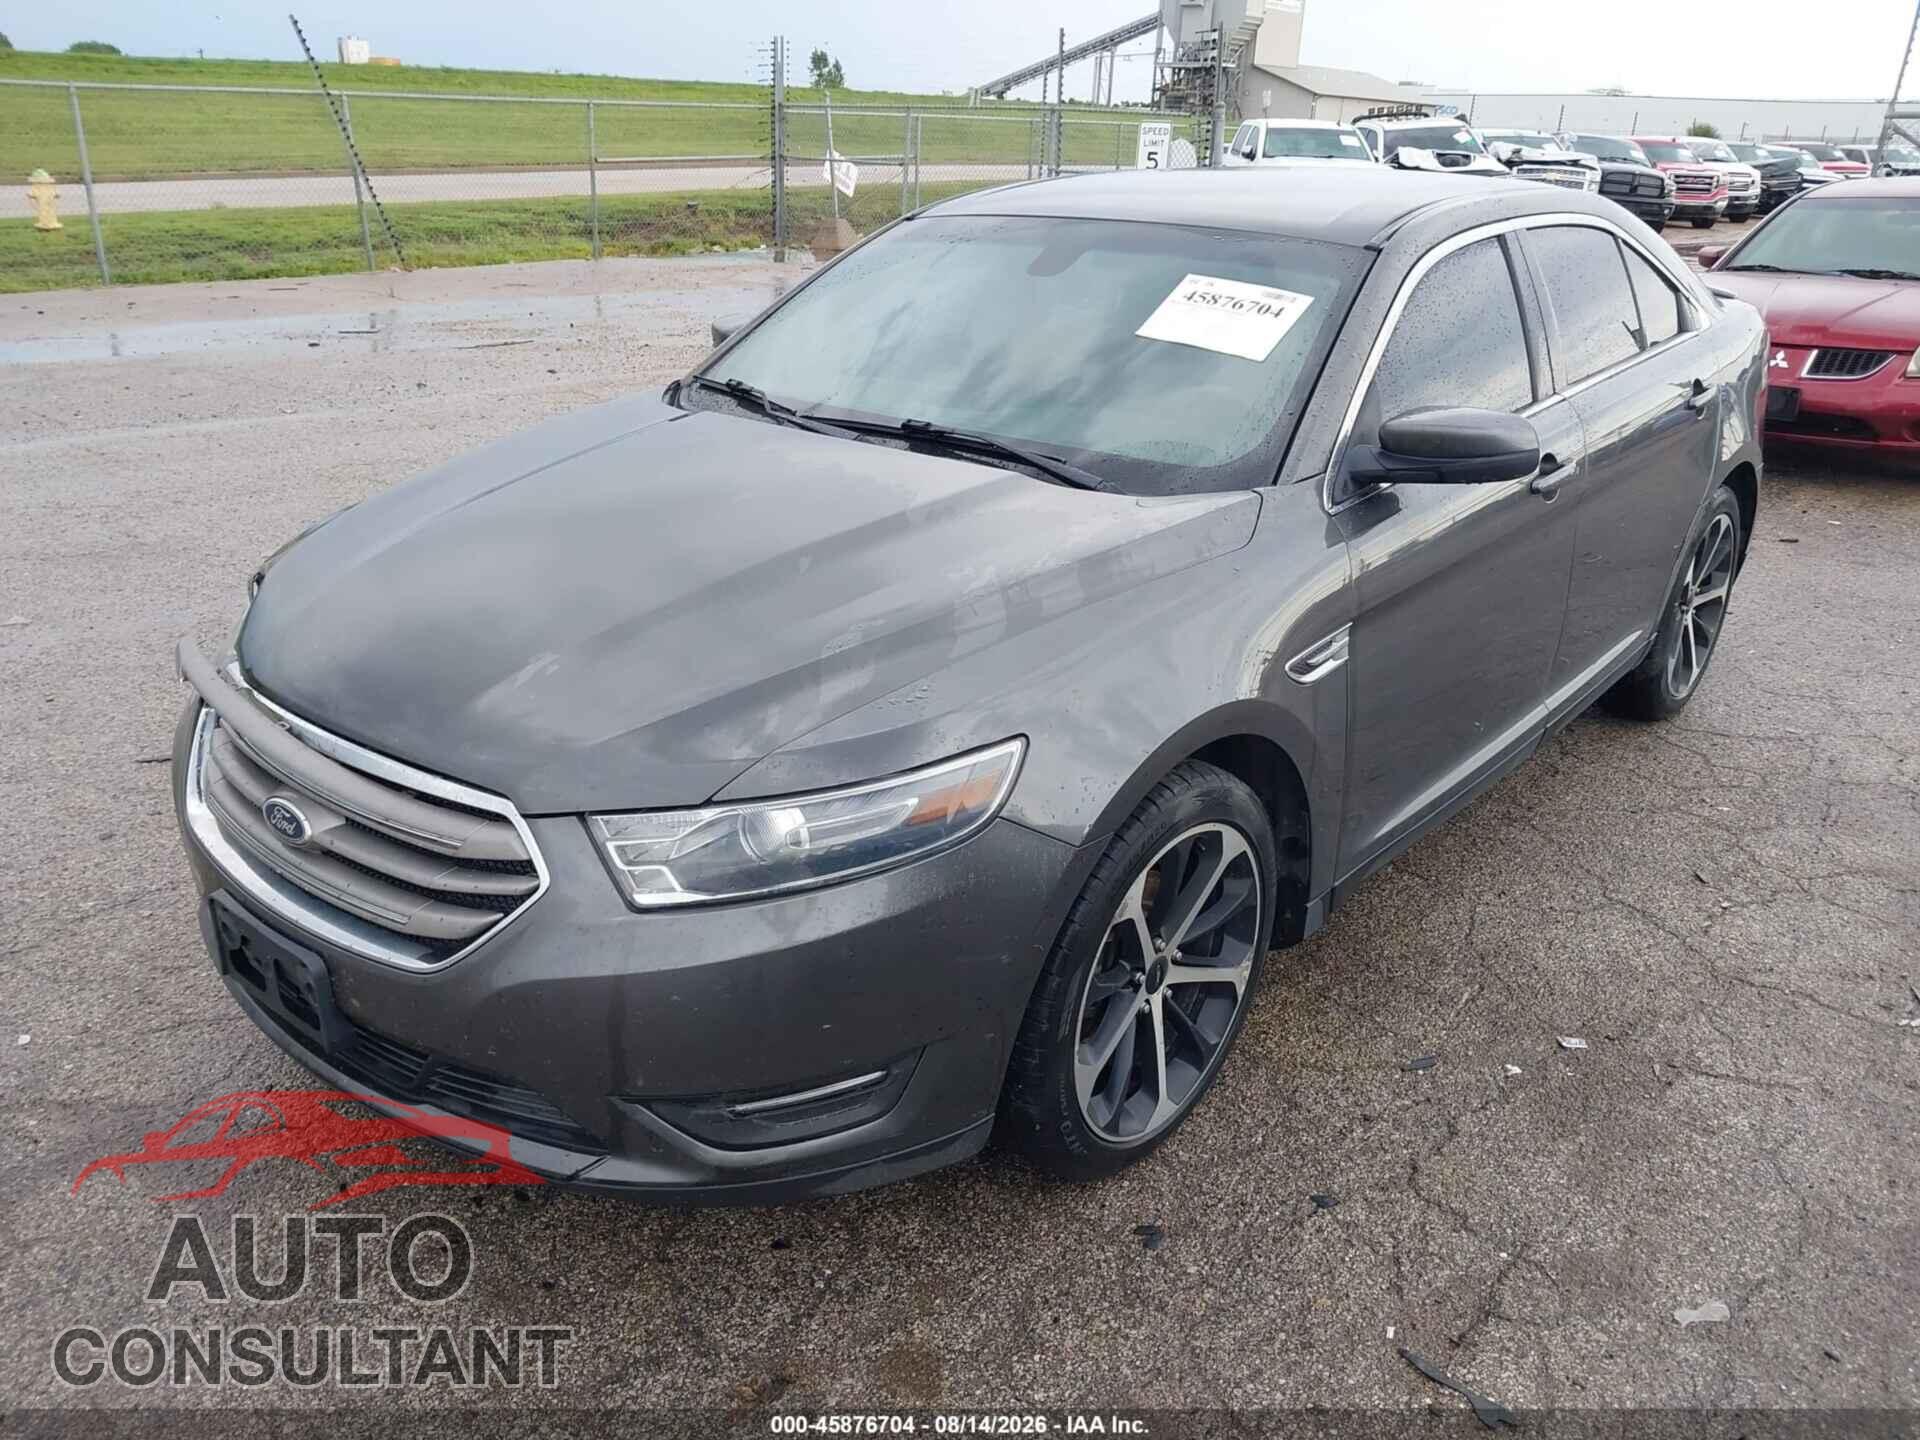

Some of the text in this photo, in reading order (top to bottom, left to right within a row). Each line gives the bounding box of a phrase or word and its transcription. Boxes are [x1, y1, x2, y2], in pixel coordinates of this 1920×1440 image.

[1141, 126, 1169, 136] SPEED
[1143, 138, 1165, 148] LIMIT
[1145, 151, 1159, 169] 5
[1183, 289, 1286, 319] 45876704
[270, 806, 297, 836] Ford
